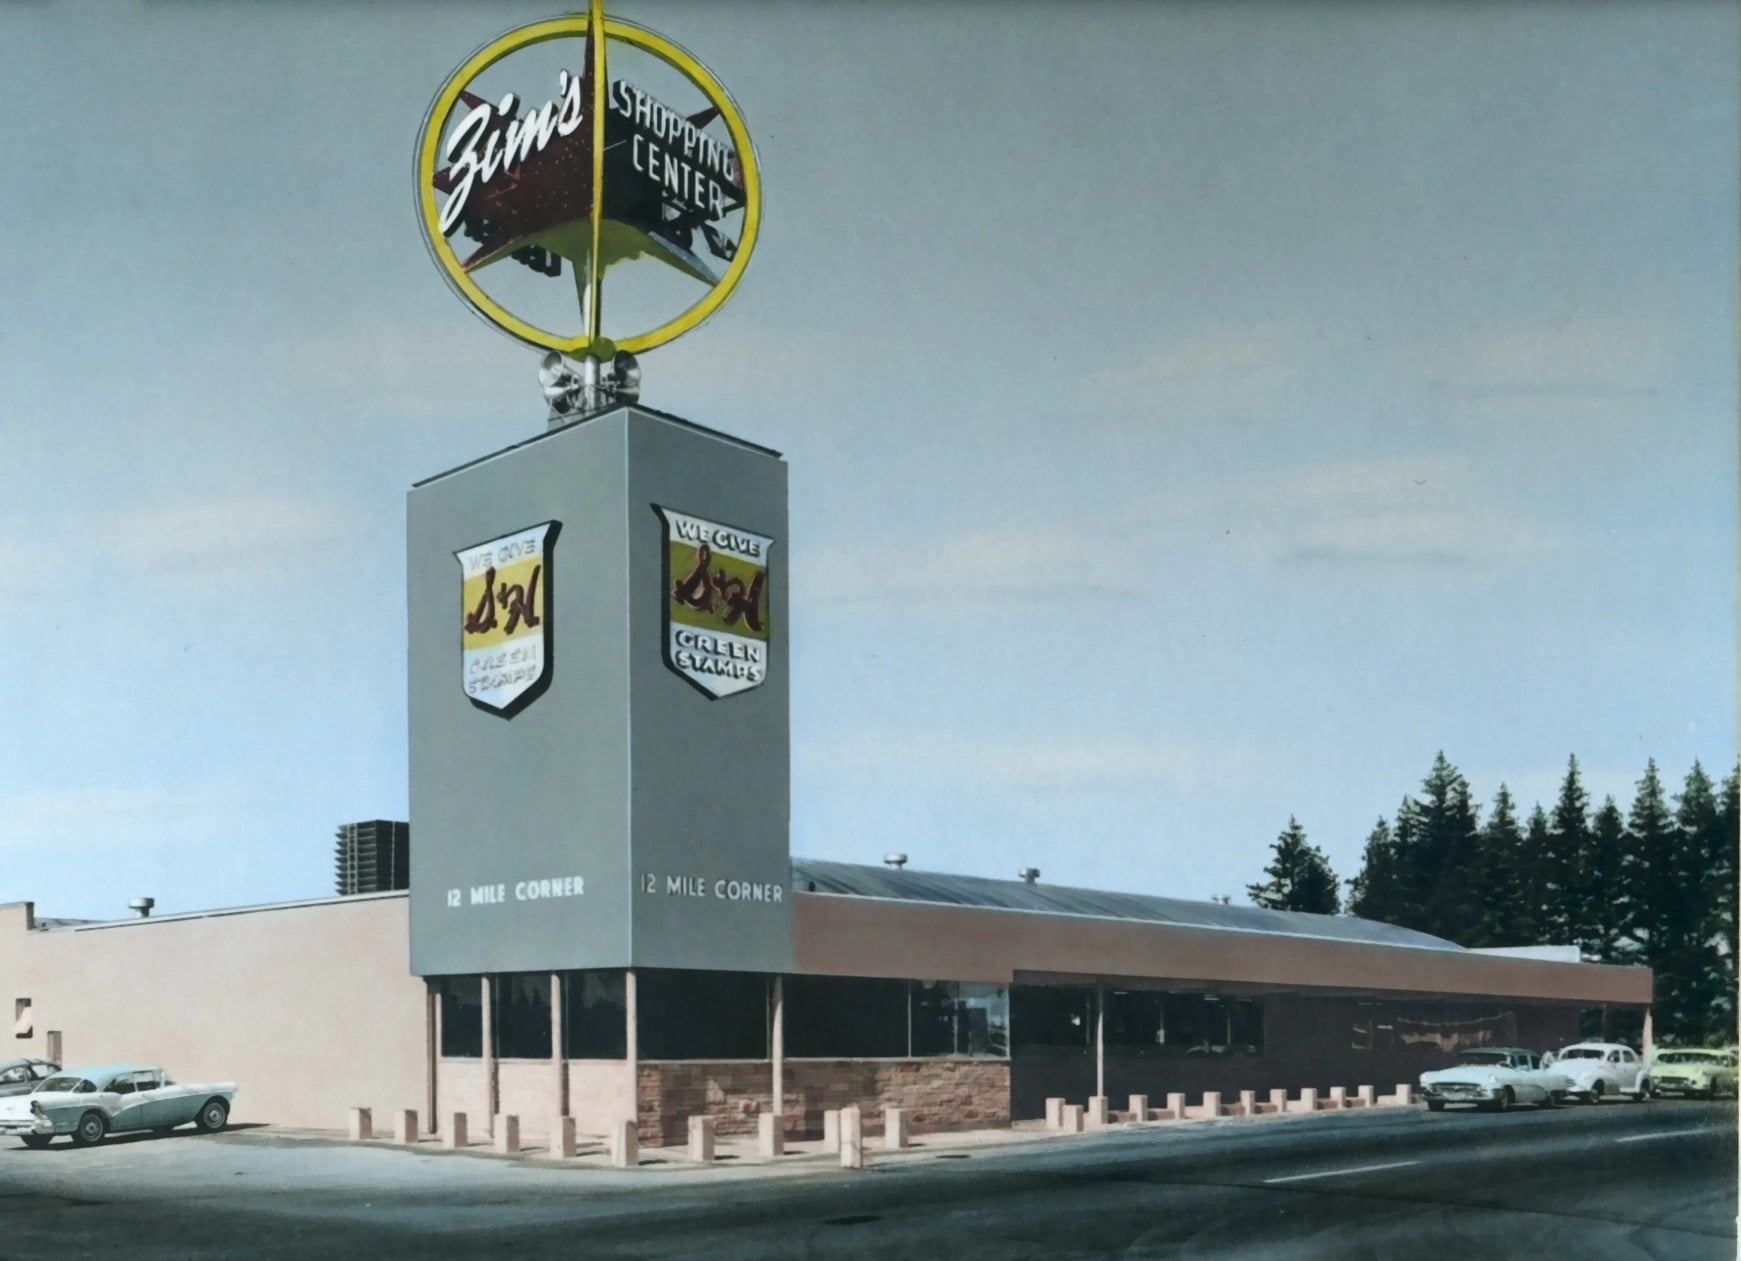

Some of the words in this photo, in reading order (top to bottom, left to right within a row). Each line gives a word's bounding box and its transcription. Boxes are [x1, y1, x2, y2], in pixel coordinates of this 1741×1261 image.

[613, 79, 735, 182] SHOPPING
[439, 68, 584, 234] Zim's
[632, 133, 725, 221] CENTER
[676, 520, 710, 543] WE
[712, 529, 761, 557] GIVE
[675, 630, 760, 663] GREEN
[675, 650, 761, 682] STAMPS
[447, 888, 462, 907] 12
[470, 883, 506, 905] MILE
[515, 875, 584, 901] CORNER
[640, 872, 657, 894] 12
[666, 874, 705, 897] MILE
[714, 879, 783, 903] CORNER
